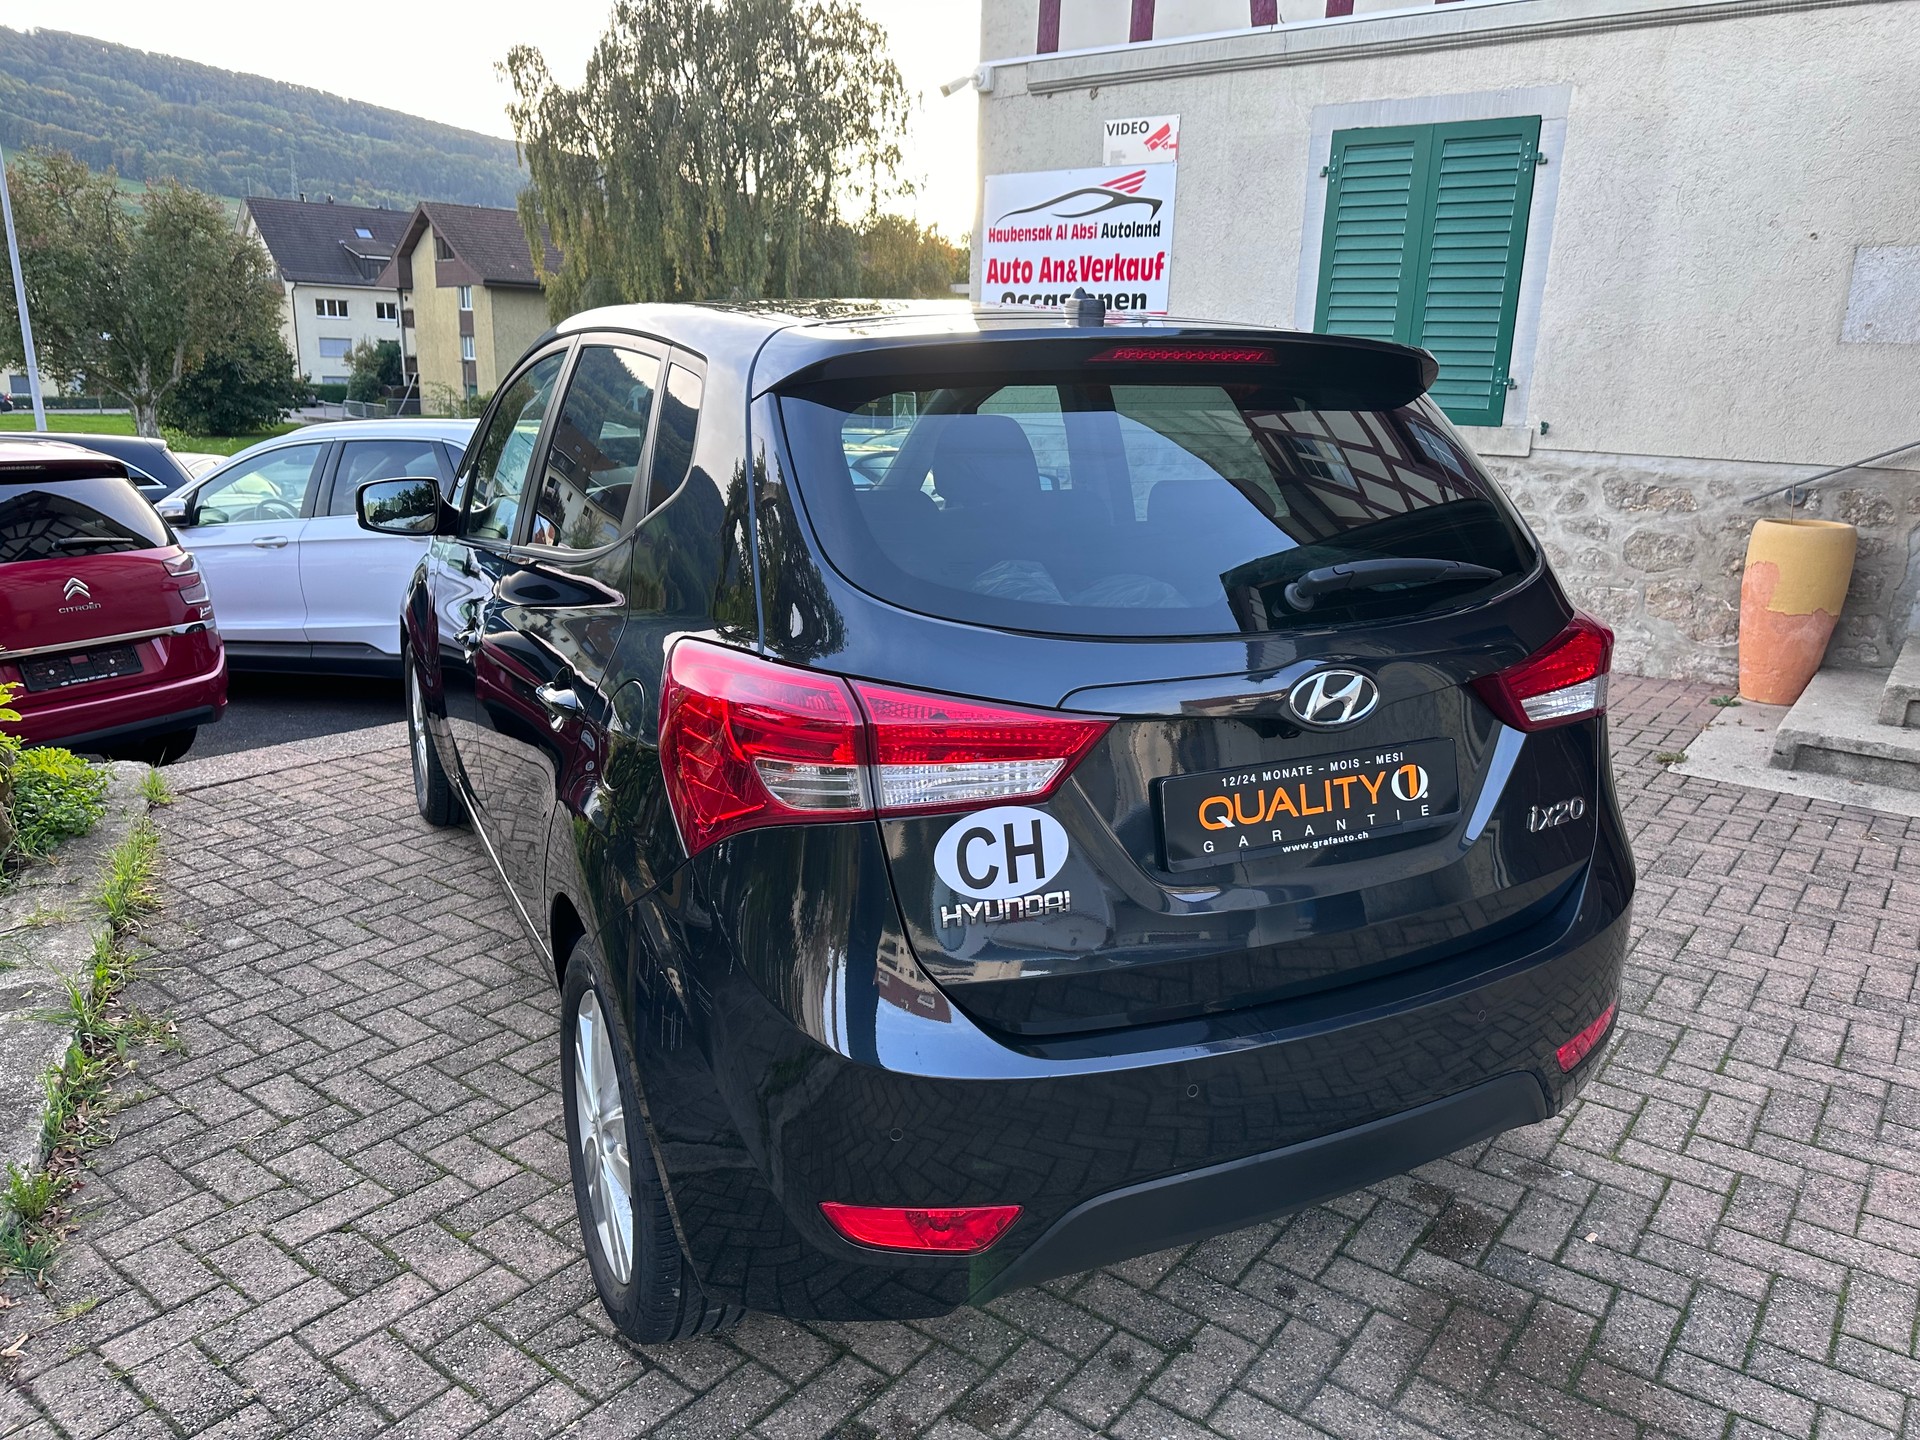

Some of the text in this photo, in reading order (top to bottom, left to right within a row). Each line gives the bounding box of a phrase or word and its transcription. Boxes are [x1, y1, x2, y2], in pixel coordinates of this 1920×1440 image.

[1105, 120, 1150, 136] VIDEO
[988, 220, 1161, 243] Haubensak Al Absi Autoland
[986, 251, 1165, 284] Auto An&Verkauf
[1000, 291, 1147, 311] Occanen
[1221, 773, 1257, 787] 12/24
[1262, 765, 1313, 782] MONATE
[1329, 758, 1360, 772] MOIS
[1375, 751, 1404, 765] MESI
[1198, 770, 1387, 831] QUALITY
[1526, 796, 1585, 833] ix20
[1203, 804, 1430, 853] GARANTIE
[1282, 831, 1369, 853] www.grafauto.ch
[956, 818, 1046, 890] CH
[940, 890, 1071, 929] HYUNDAI
